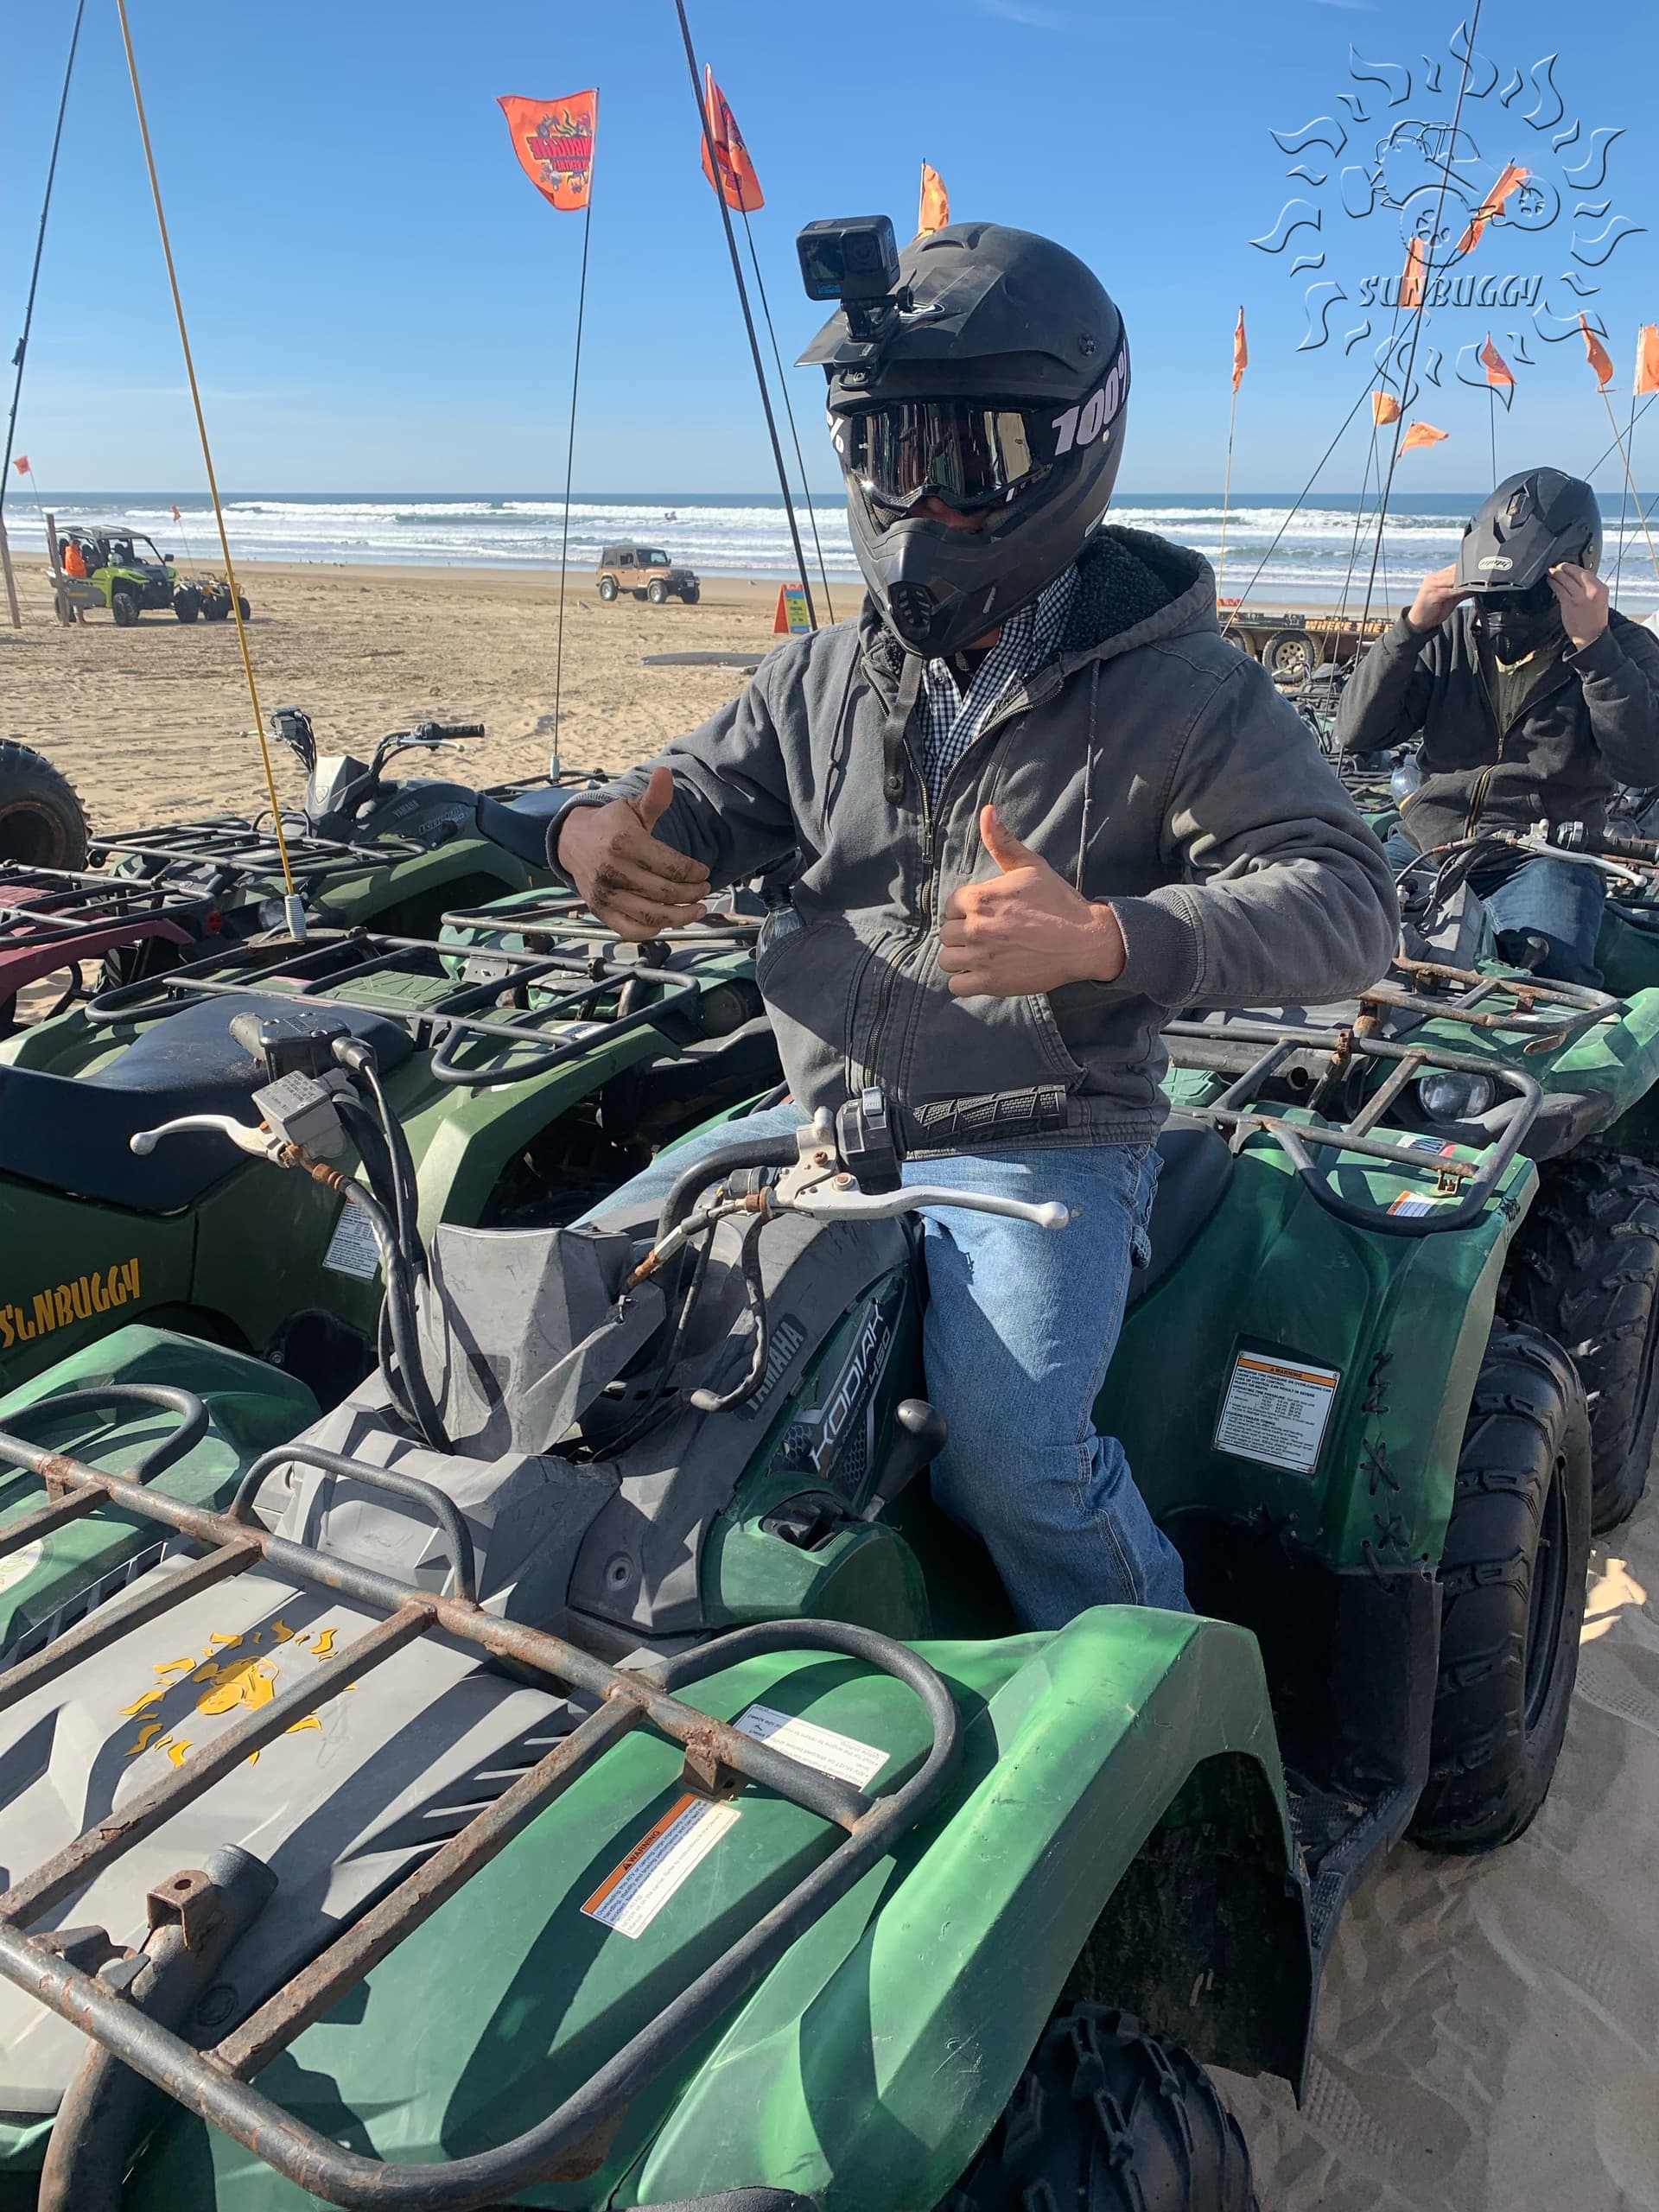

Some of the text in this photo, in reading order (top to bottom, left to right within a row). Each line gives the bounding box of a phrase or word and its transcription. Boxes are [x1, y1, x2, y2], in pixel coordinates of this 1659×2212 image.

[868, 1327, 891, 1386] 450
[808, 1303, 885, 1471] KODIAK
[626, 1829, 660, 1863] WARNING
